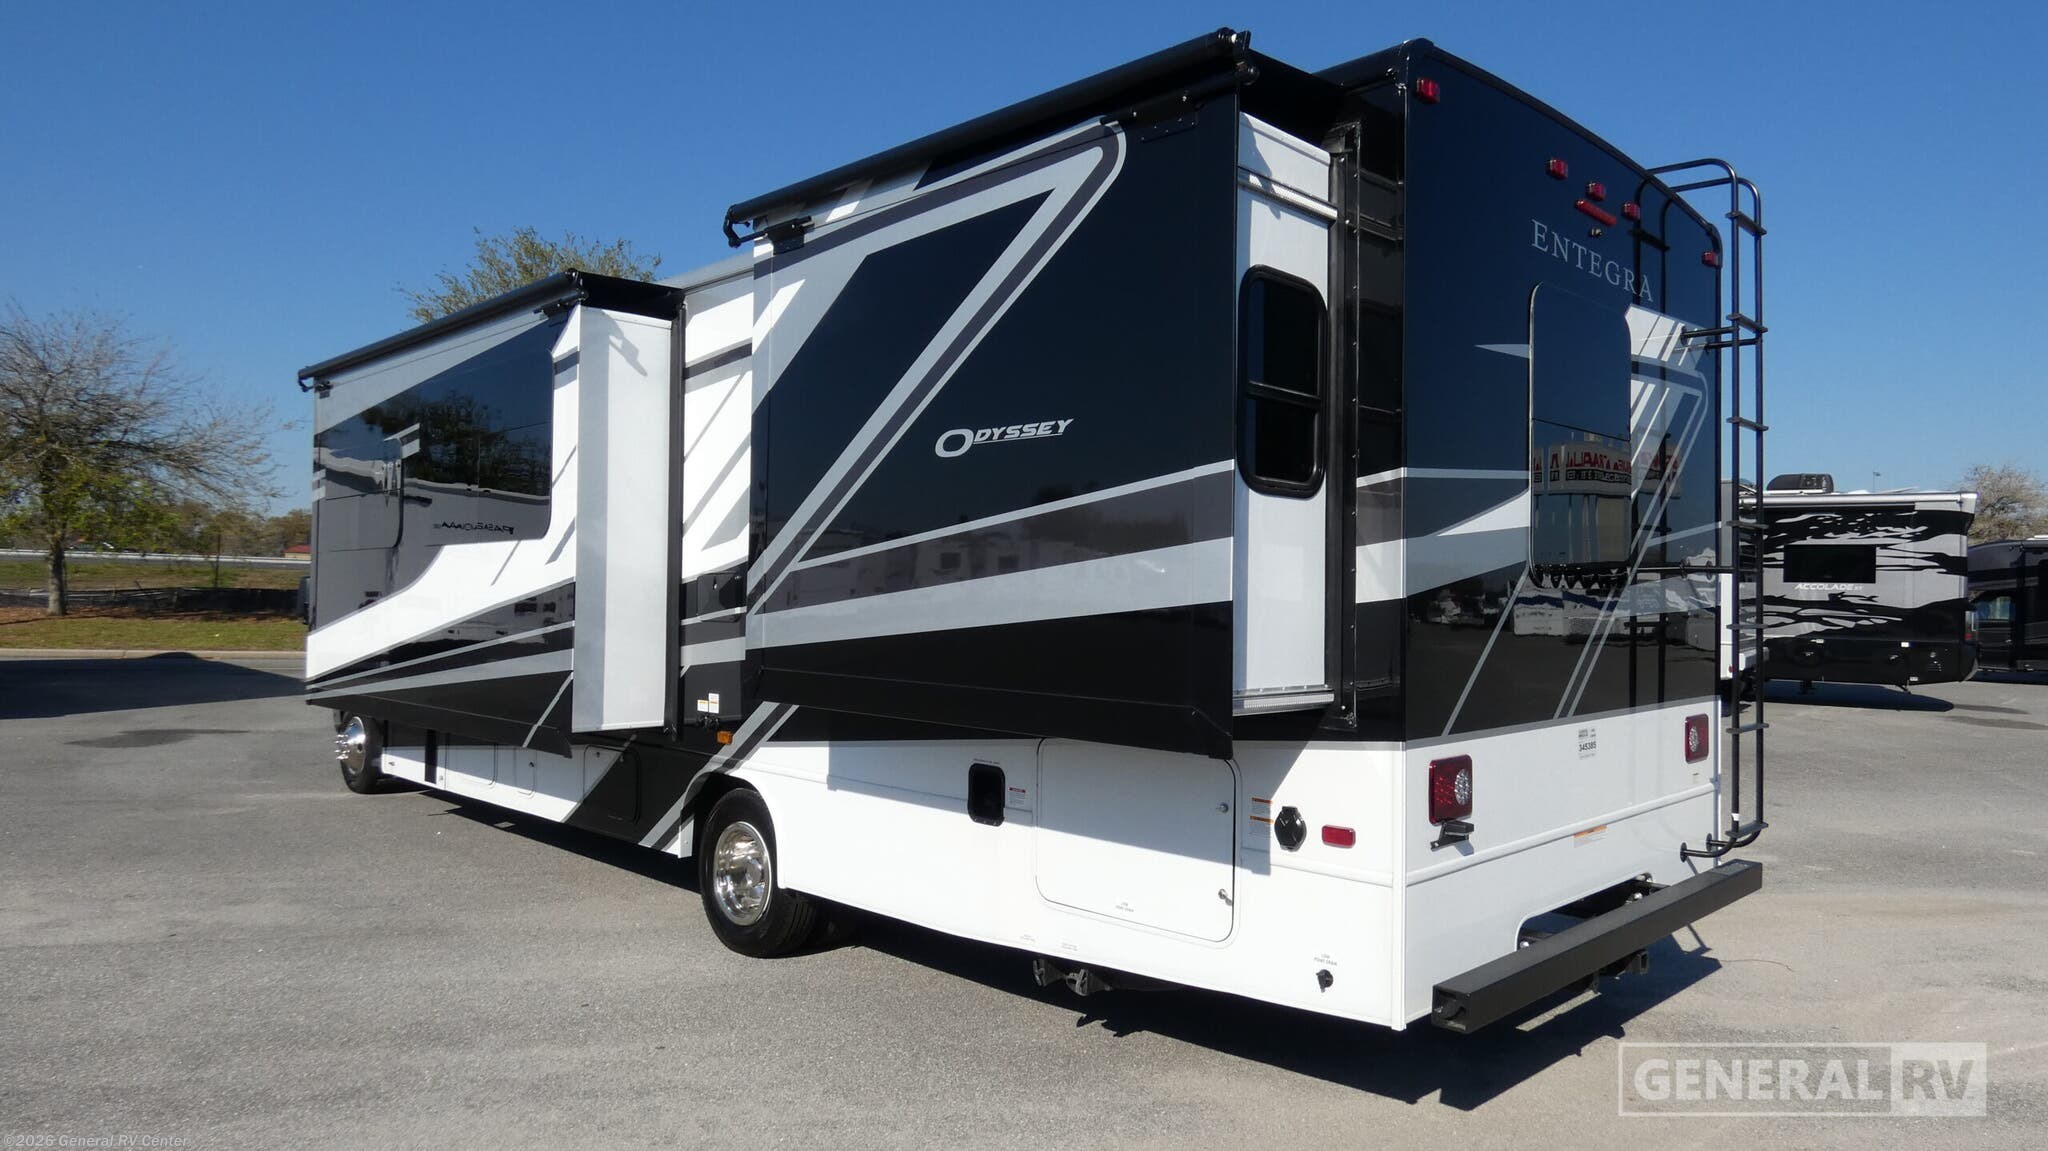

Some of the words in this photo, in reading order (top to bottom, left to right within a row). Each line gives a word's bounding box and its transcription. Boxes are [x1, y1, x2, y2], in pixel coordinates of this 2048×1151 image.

[1530, 218, 1654, 303] ENTEGRA
[934, 418, 1075, 458] ODYSSEY
[1794, 583, 1855, 591] ACCOLADE
